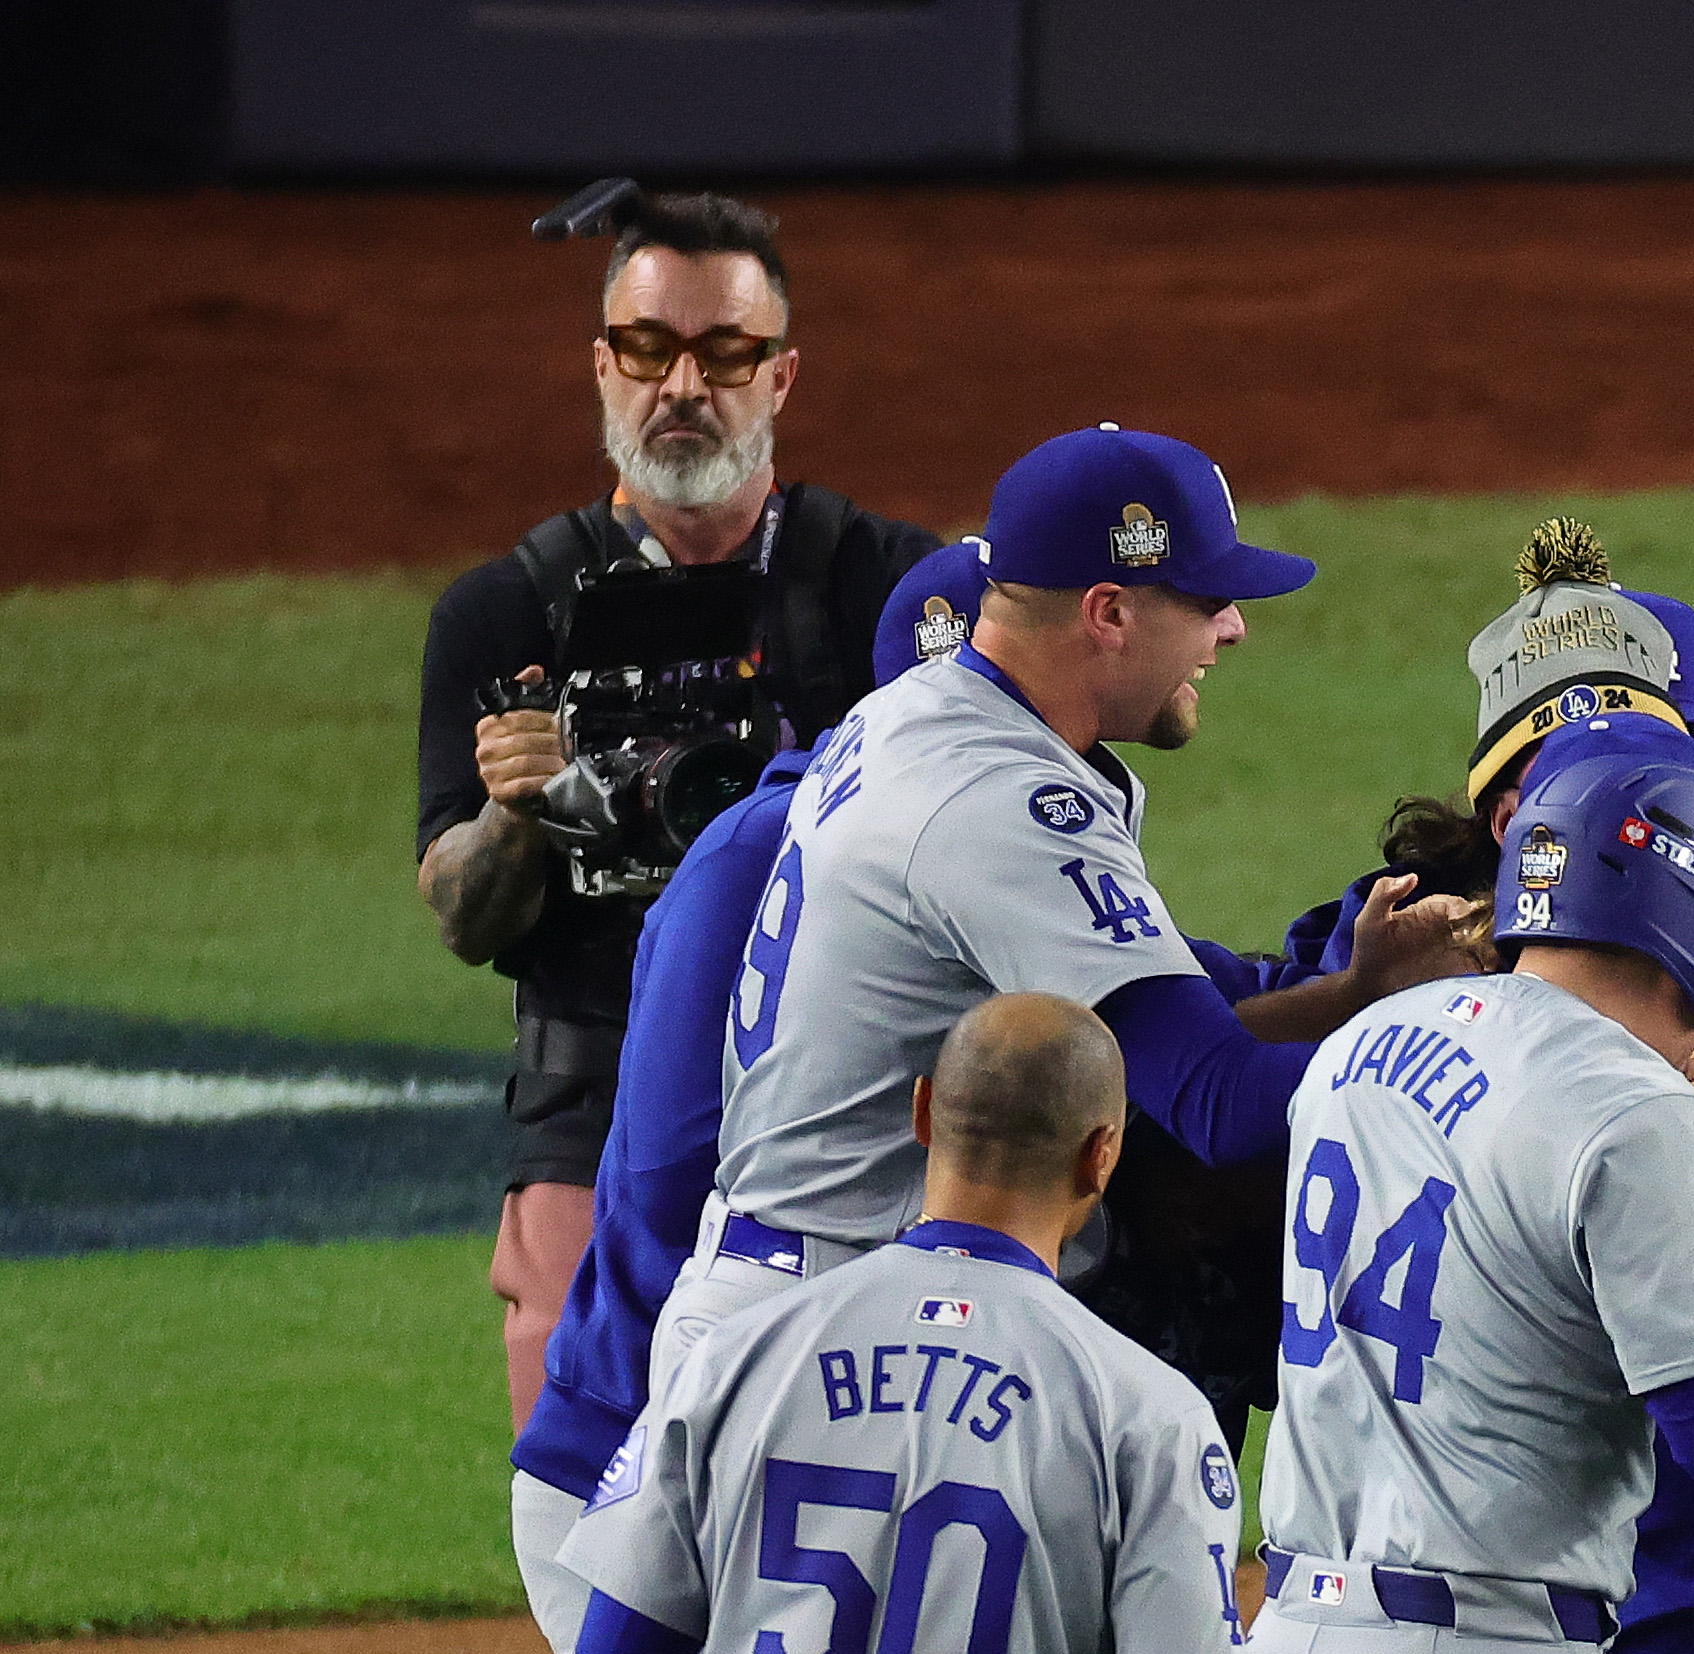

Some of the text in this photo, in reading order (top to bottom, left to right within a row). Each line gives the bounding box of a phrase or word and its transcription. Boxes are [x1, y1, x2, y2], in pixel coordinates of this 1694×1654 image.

[1113, 528, 1166, 545] WORLD
[1117, 541, 1166, 557] SERIES
[917, 619, 966, 640] WORLD
[1521, 604, 1619, 644] WORLD
[1521, 626, 1620, 666] SERIES
[1043, 798, 1087, 826] 34
[1521, 864, 1559, 880] SERIES
[1522, 852, 1561, 867] WORLD
[1058, 857, 1161, 945] LA
[1516, 891, 1551, 930] 94
[1331, 1023, 1492, 1140] JAVIER
[1281, 1136, 1458, 1405] 94
[818, 1343, 1032, 1443] BETTS
